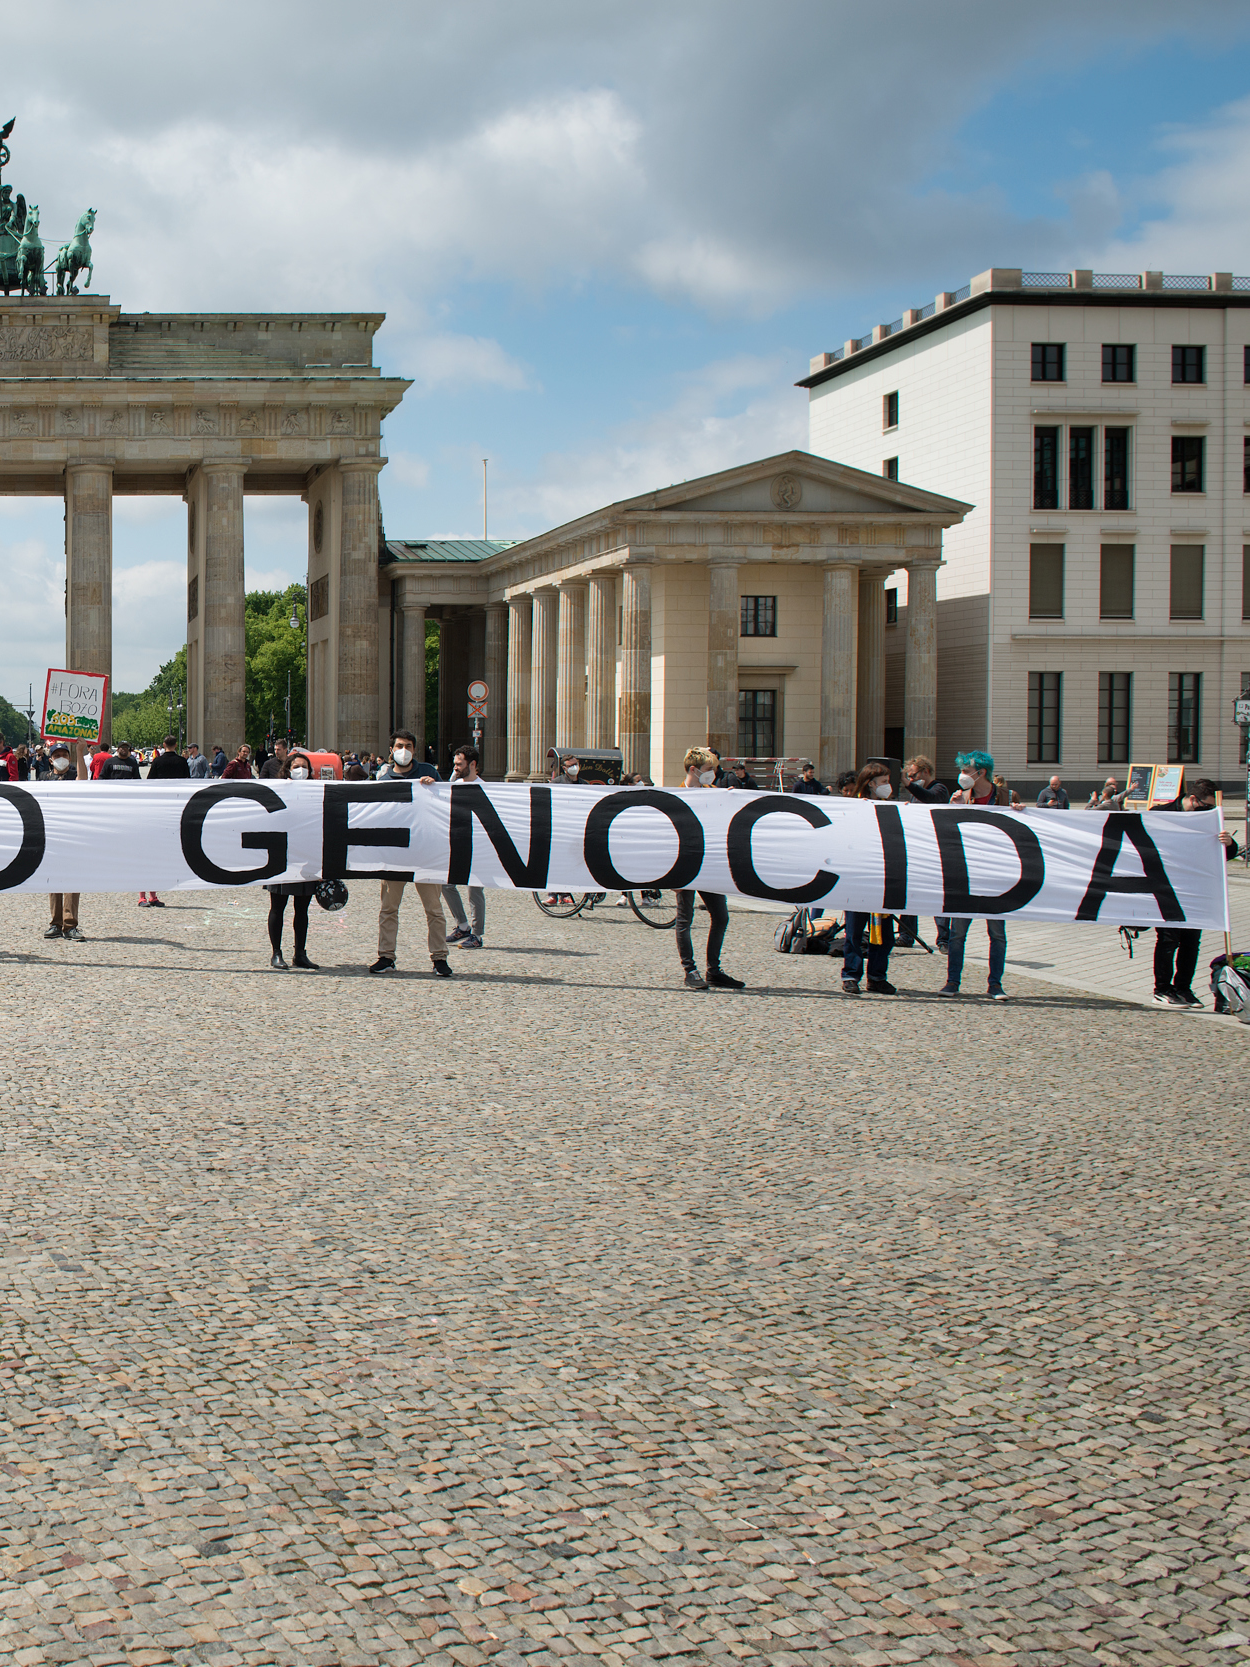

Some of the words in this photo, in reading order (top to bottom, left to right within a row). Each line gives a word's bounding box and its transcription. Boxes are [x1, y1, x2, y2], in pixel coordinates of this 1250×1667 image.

[51, 682, 98, 701] #FORA
[60, 700, 98, 716] BOZO
[51, 713, 77, 726] SOS
[47, 724, 99, 740] AMAZONAS
[181, 781, 1186, 923] GENOCIDA
